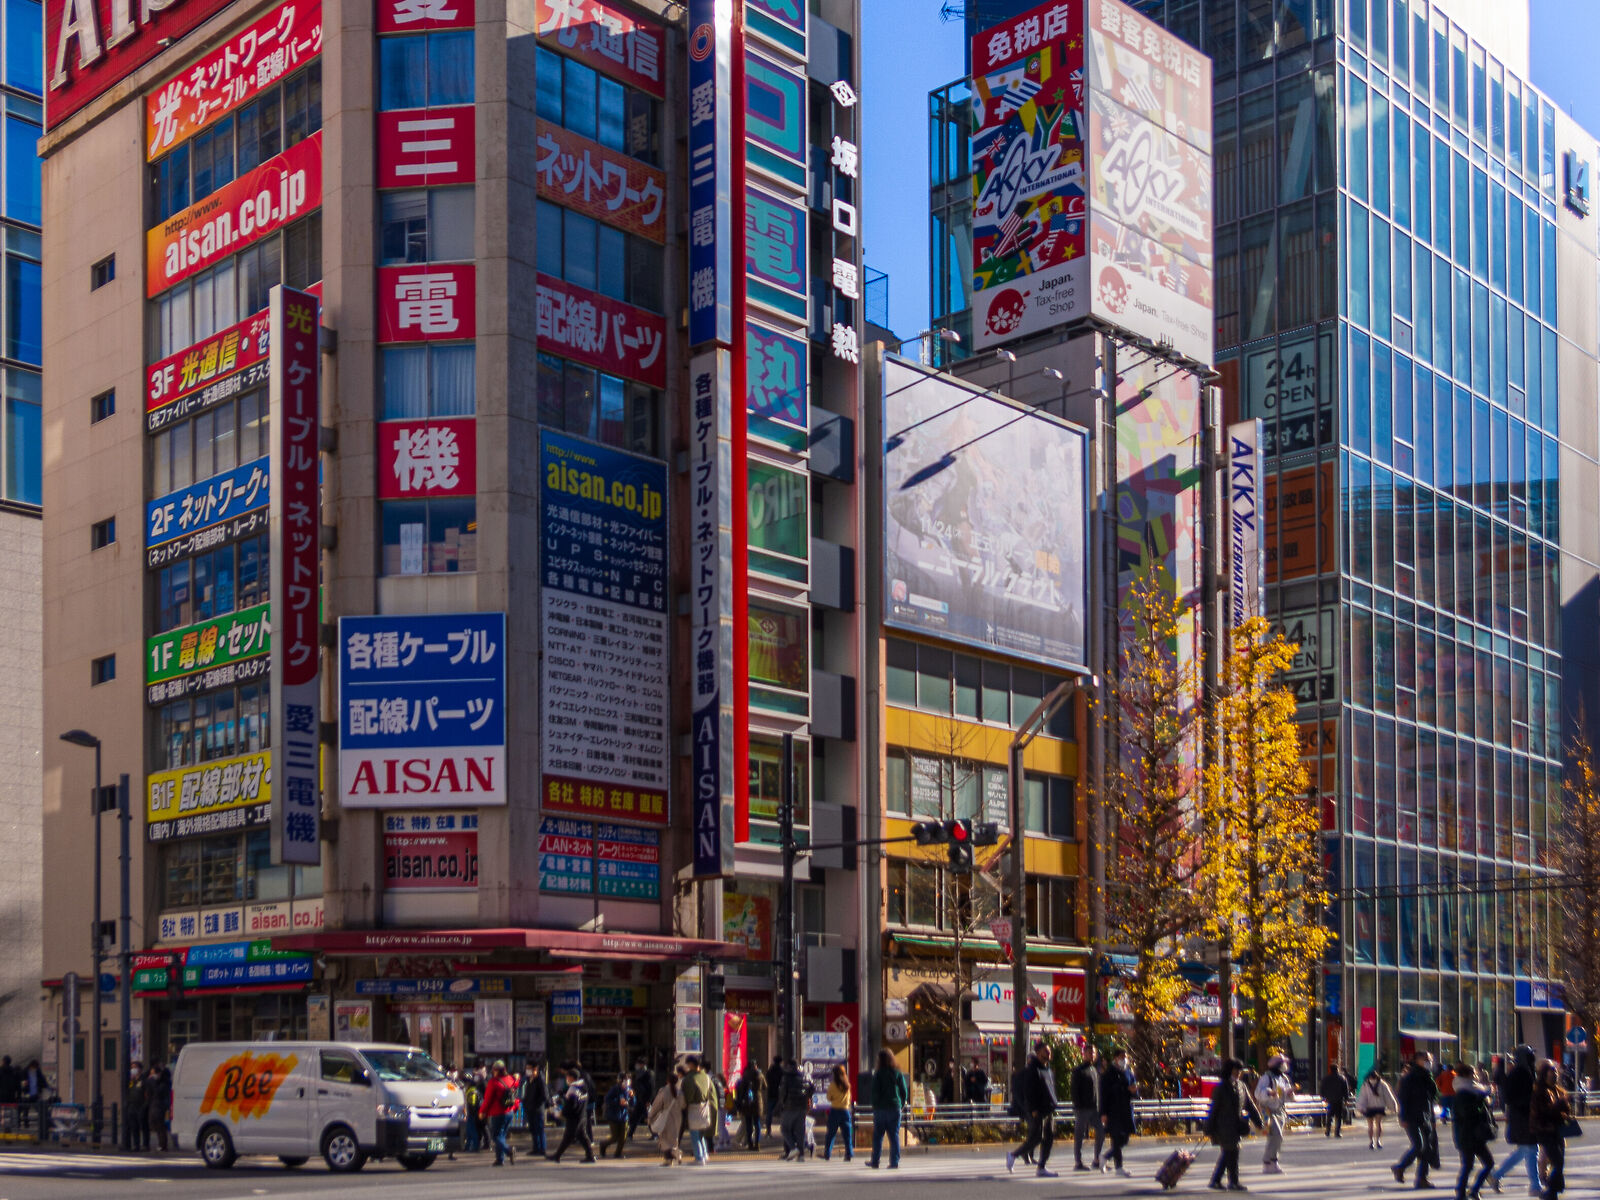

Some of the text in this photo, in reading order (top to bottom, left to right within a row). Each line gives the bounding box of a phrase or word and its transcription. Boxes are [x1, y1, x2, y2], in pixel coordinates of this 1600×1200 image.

[987, 3, 1069, 66] 免税店
[536, 133, 664, 225] ネットワーク
[983, 150, 1058, 204] AKKY
[1019, 167, 1078, 196] INTERNATIONAL
[1106, 149, 1181, 201] AKKY
[692, 79, 714, 311] 愛三電機
[164, 197, 223, 238] http://www.
[166, 169, 305, 278] aisan.co.jp
[1145, 196, 1200, 232] INTERNATIONAL
[831, 135, 858, 364] 坂口電熱
[1034, 287, 1075, 308] Tax-free
[1038, 273, 1075, 292] Japan.
[536, 285, 662, 369] 配線パーツ
[1049, 302, 1075, 316] Shop
[1133, 298, 1209, 343] Japan. Tax-free Shop
[151, 365, 175, 400] 3F
[1264, 383, 1316, 411] OPEN
[547, 443, 598, 467] http://www.
[287, 304, 313, 666] 光・ケーブル・ネットワーク
[547, 461, 662, 520] aisan.co.jp
[1231, 436, 1255, 531] AKKY
[151, 502, 175, 537] 2F
[695, 373, 714, 695] 各種ケーブル・ネットワーク機器
[151, 640, 174, 672] 1F
[348, 629, 496, 670] 各種ケーブル
[349, 696, 494, 735] 配線パーツ
[286, 704, 315, 843] 愛三電機
[349, 757, 495, 795] AISAN
[698, 716, 715, 857] AISAN
[151, 777, 175, 811] B1F
[549, 781, 663, 814] 各社 特約 在庫 直販
[386, 816, 405, 830] 各社
[411, 816, 431, 830] 特約
[436, 815, 455, 830] 在庫
[386, 836, 448, 846] http://www.
[387, 848, 478, 882] aisan.co.jp
[162, 911, 239, 938] 各社 特約 在庫 直販
[366, 934, 472, 946] http://www.aisan.co.jp
[417, 980, 444, 992] 1949
[978, 983, 1001, 1004] UQ
[1056, 986, 1082, 1004] au
[223, 1065, 274, 1103] Bee
